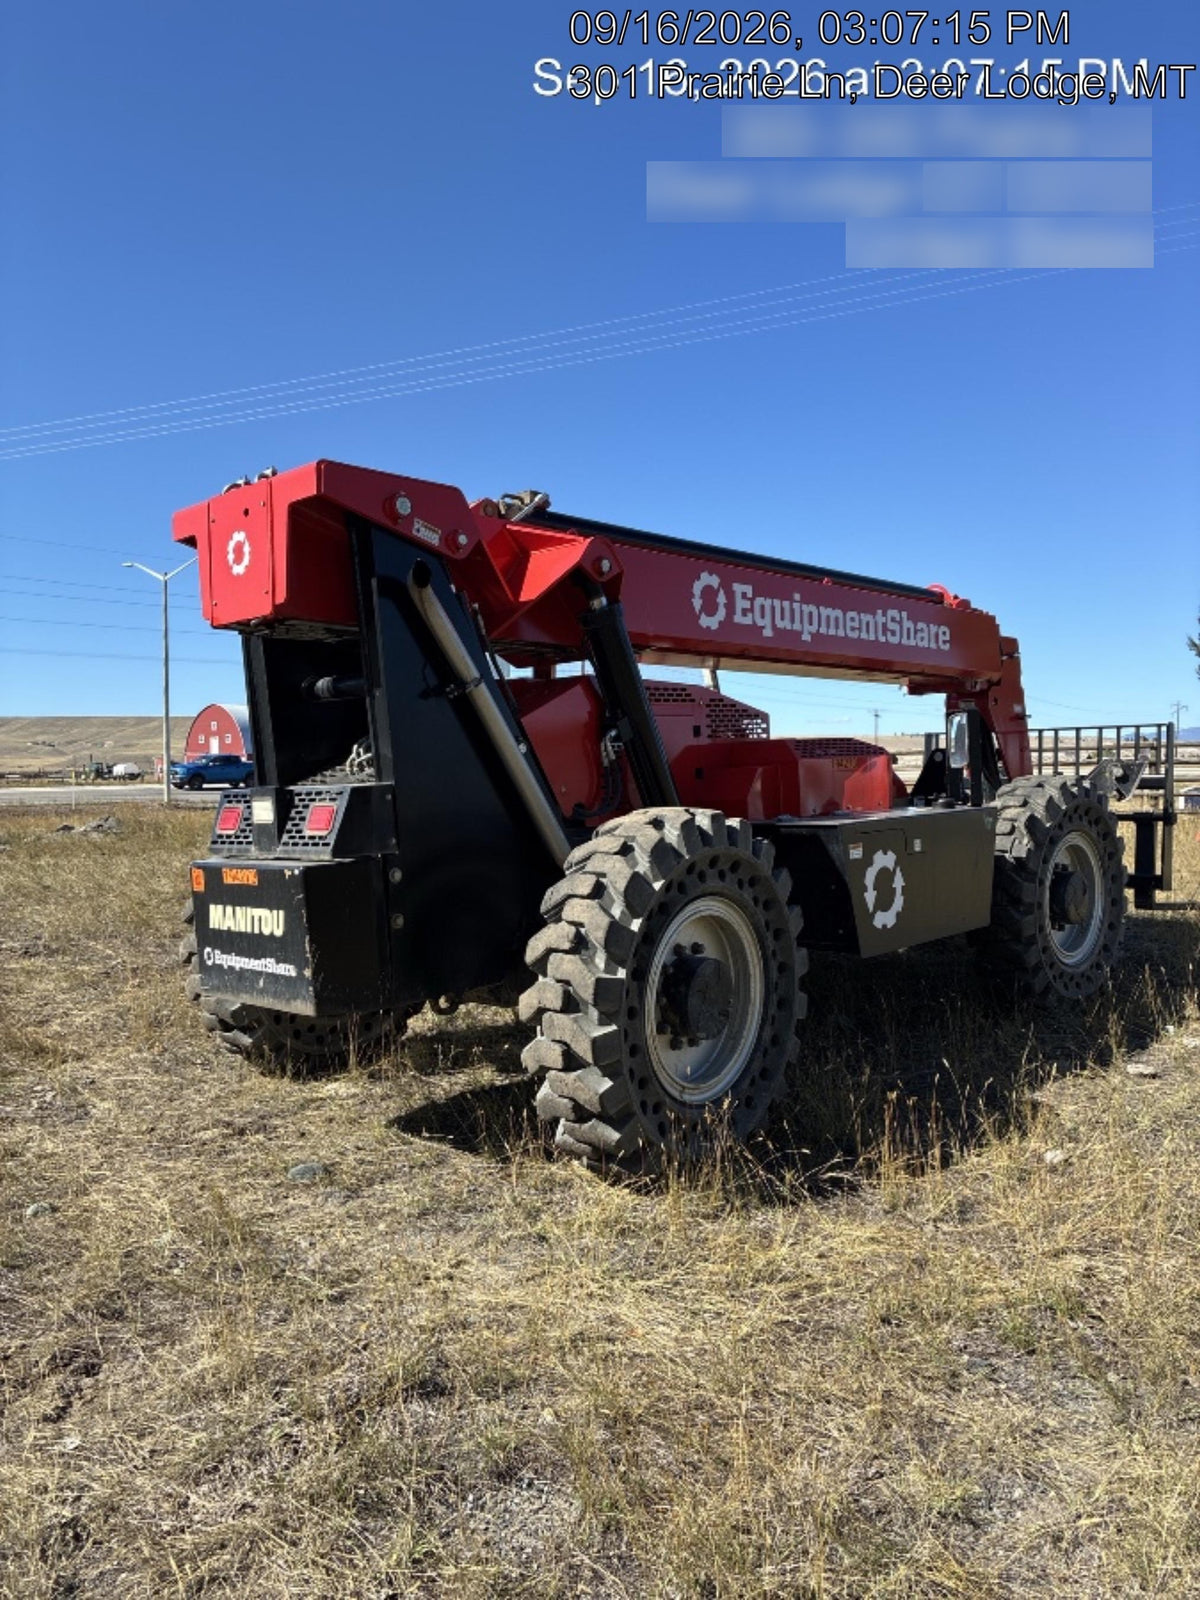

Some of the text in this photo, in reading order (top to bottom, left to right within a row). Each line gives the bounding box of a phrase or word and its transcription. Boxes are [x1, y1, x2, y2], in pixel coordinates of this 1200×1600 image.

[732, 583, 951, 651] EquipmentShare
[208, 903, 285, 938] MANITOU
[214, 950, 298, 977] EquipmentShare
